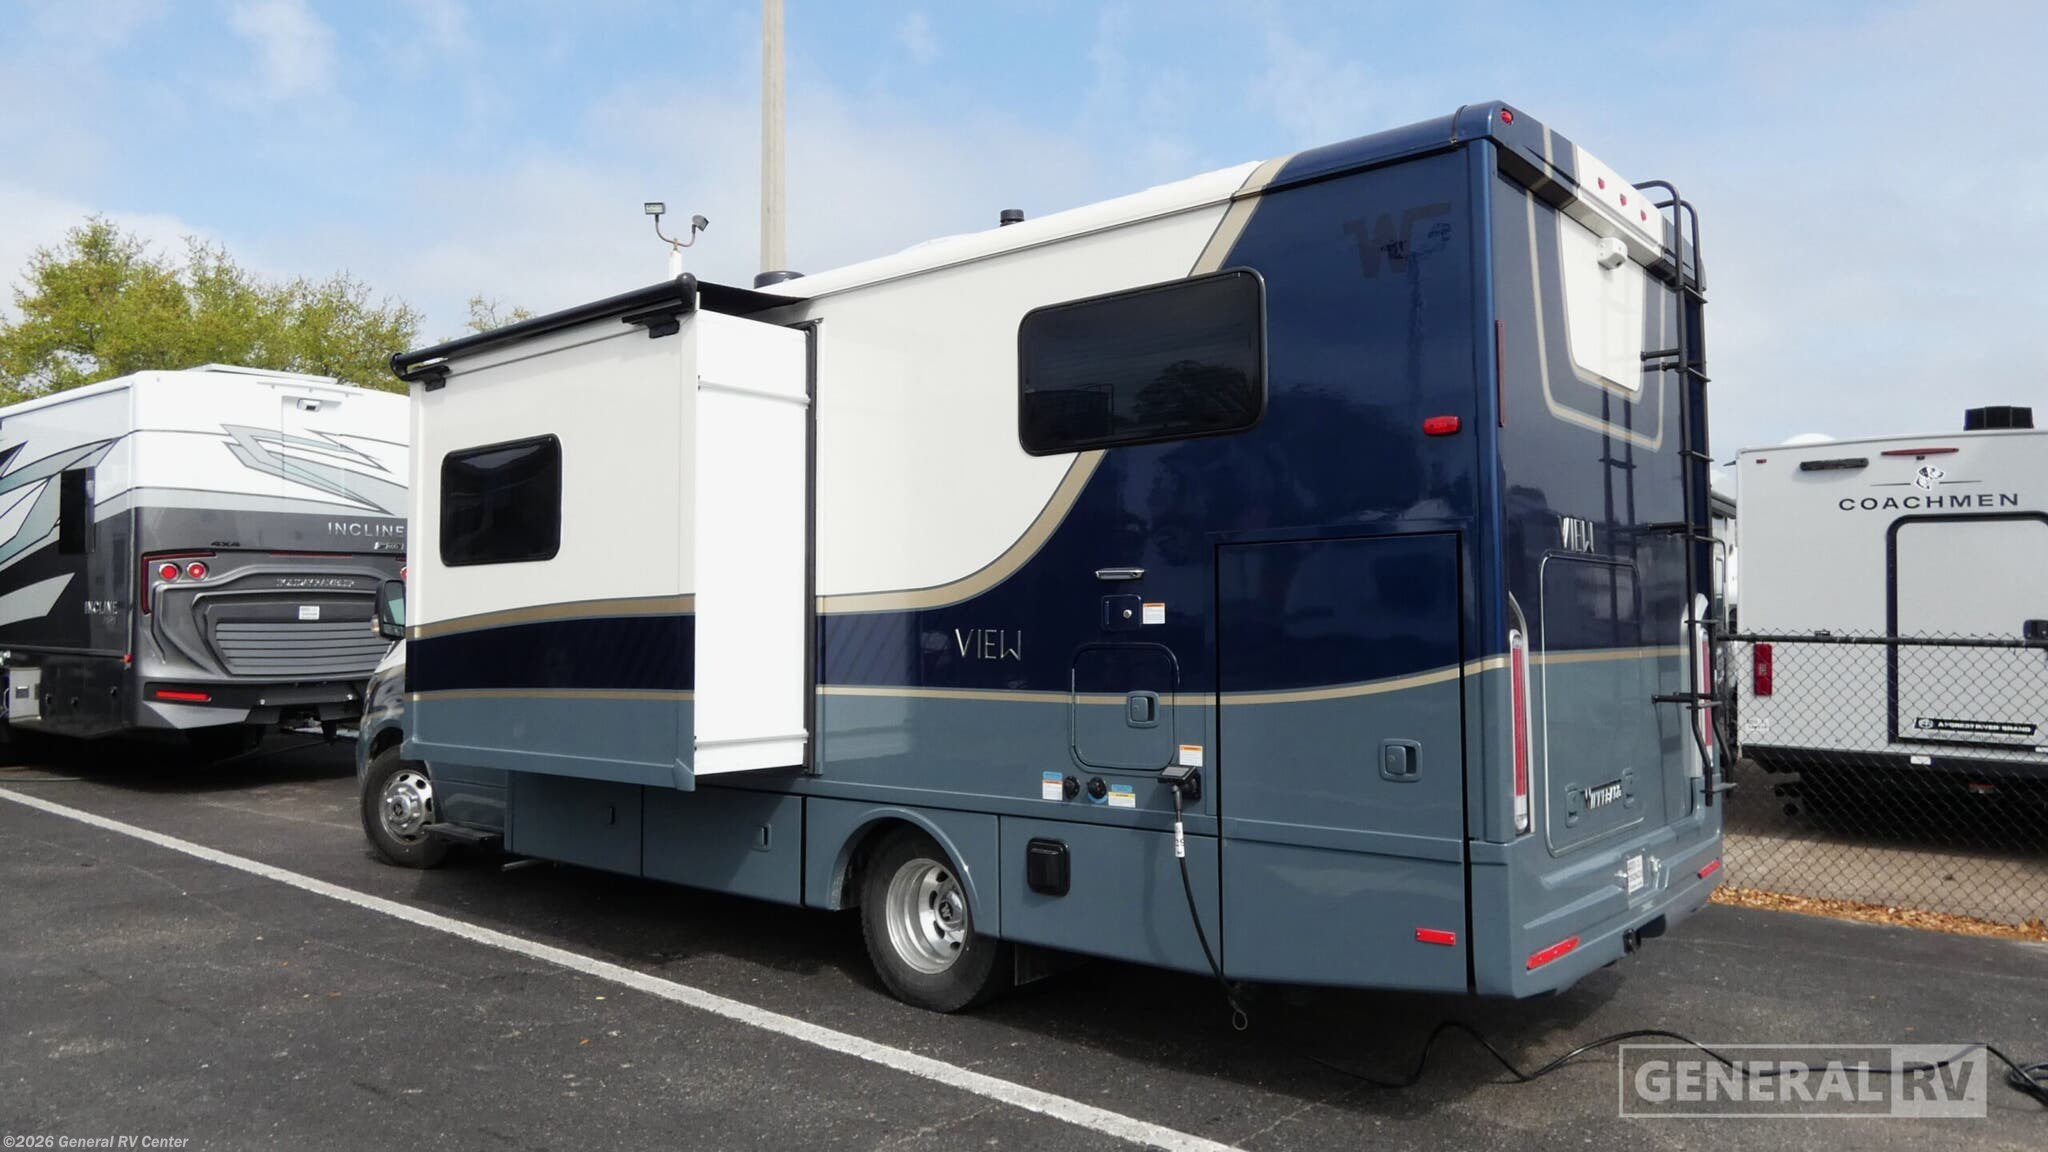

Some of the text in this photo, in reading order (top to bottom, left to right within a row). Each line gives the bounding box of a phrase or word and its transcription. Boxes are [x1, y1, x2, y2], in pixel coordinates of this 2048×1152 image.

[1838, 493, 2019, 512] COACHMEN
[327, 522, 405, 537] INCLINE
[1557, 515, 1594, 553] VIEW
[955, 628, 1022, 661] VIEW
